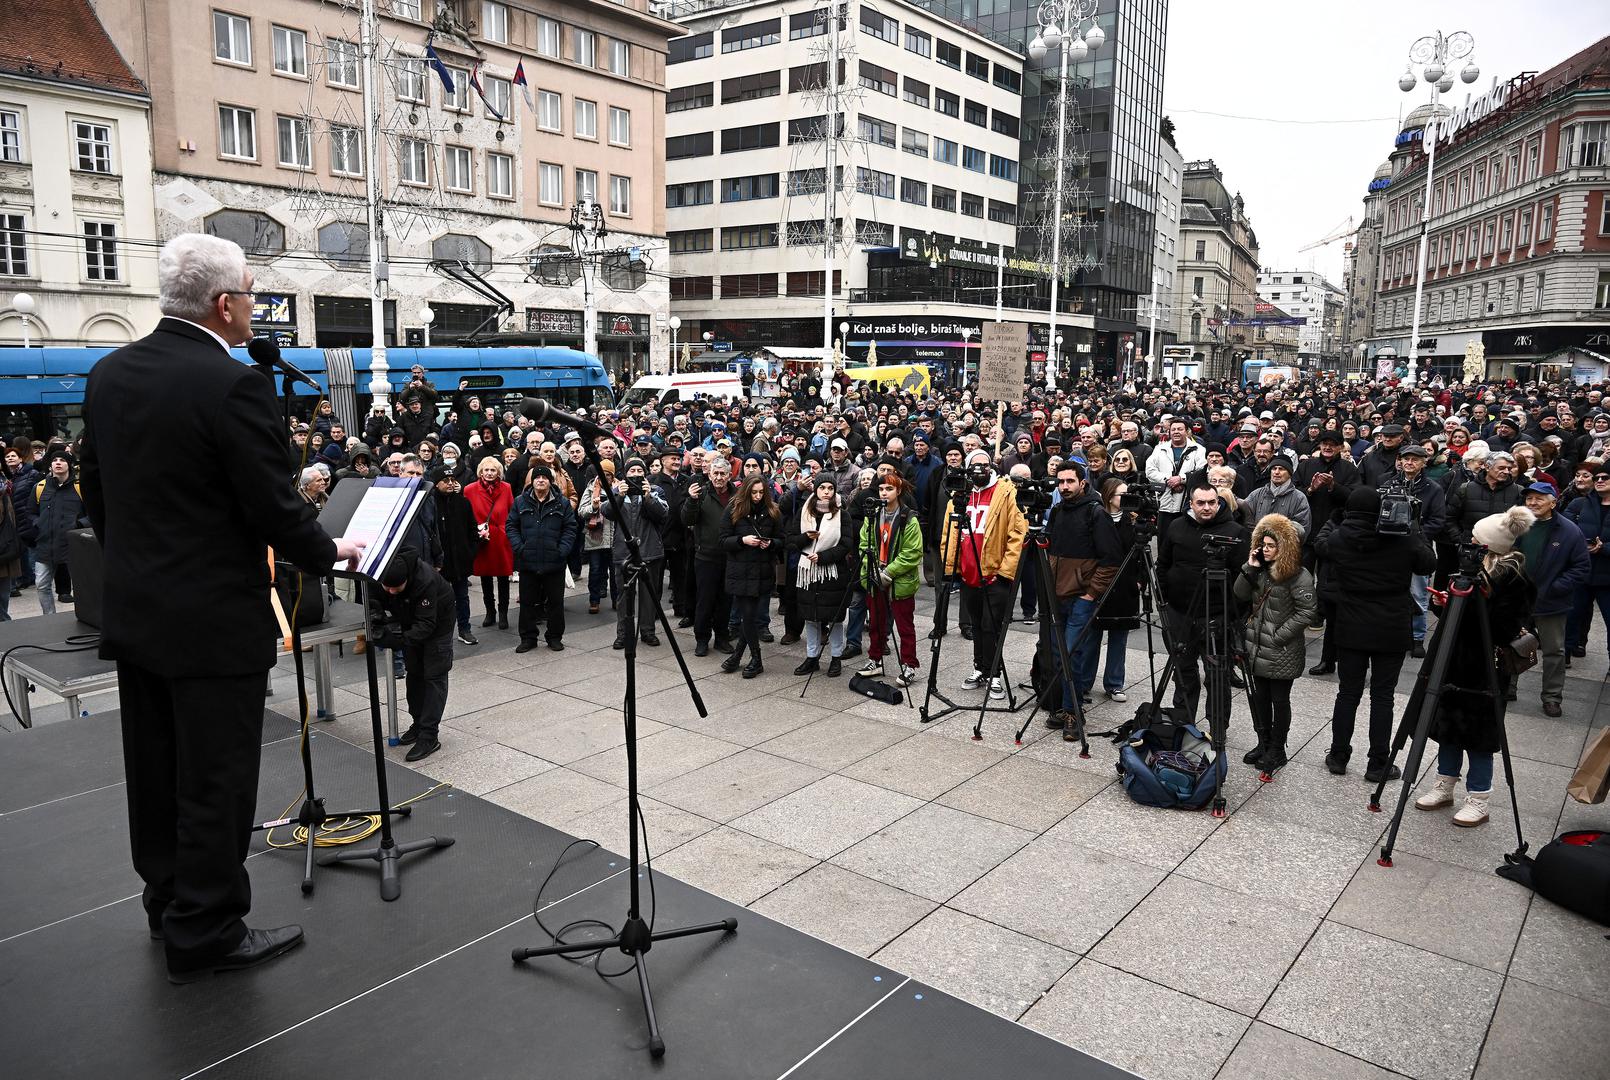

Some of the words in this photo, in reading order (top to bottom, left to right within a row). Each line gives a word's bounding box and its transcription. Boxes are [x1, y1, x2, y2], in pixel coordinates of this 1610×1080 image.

[992, 256, 1008, 267] GRDA.
[531, 312, 575, 322] AMERICAN
[854, 324, 872, 333] Kad
[875, 324, 896, 333] znaš
[899, 324, 928, 335] bolje,
[931, 324, 951, 333] biraš
[953, 324, 981, 335] Teleach.
[1585, 334, 1610, 345] ZA
